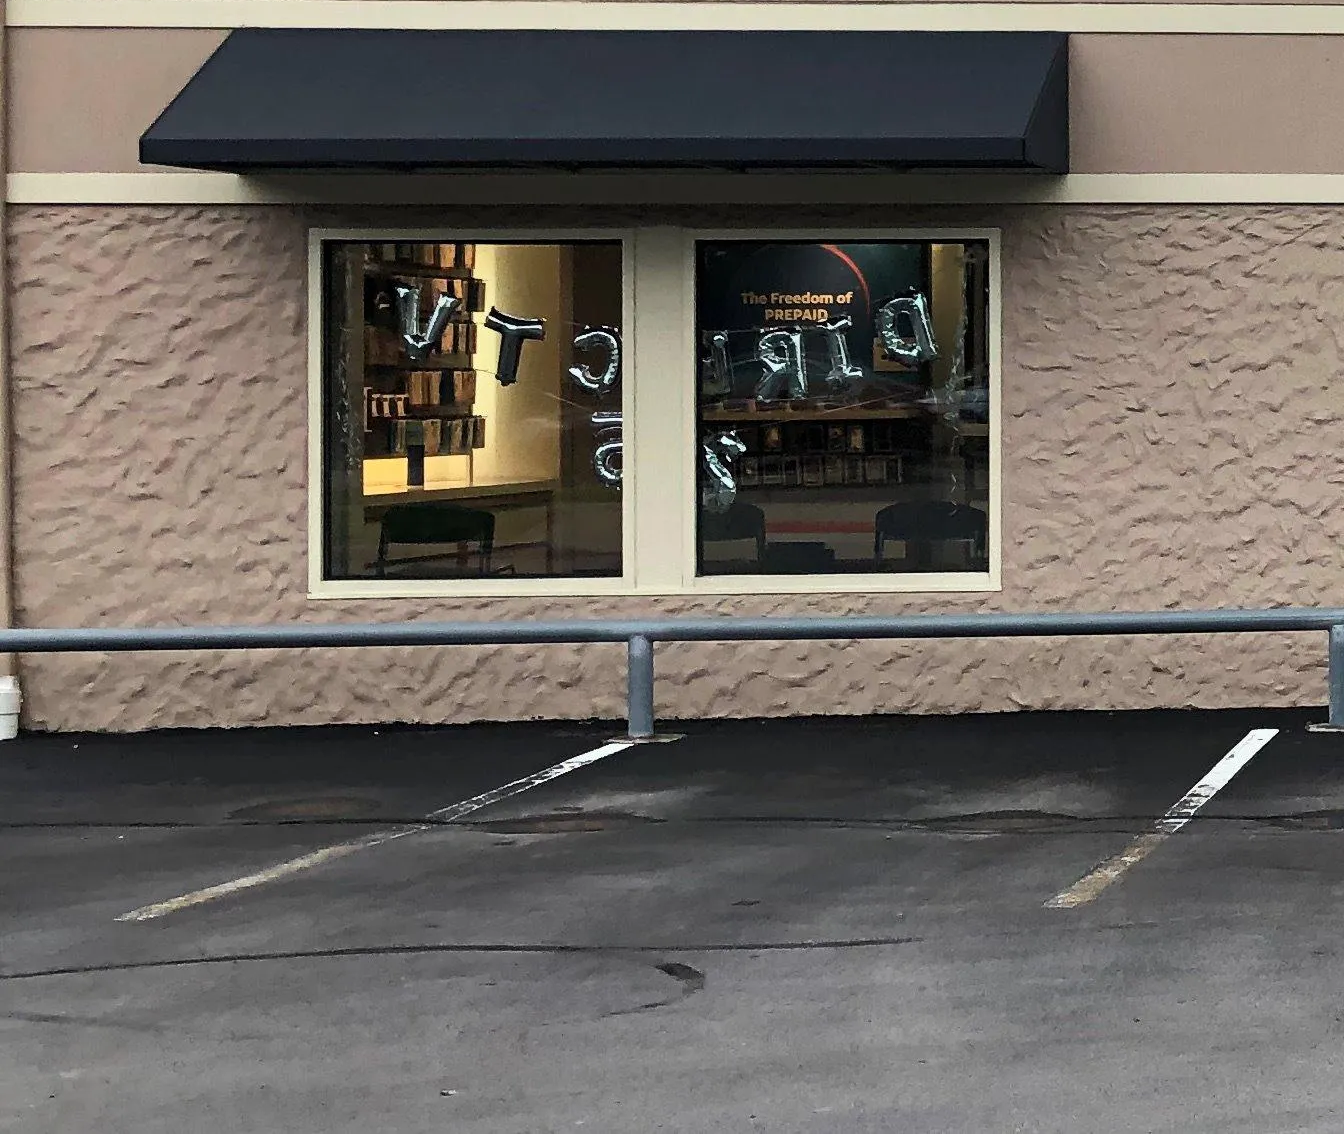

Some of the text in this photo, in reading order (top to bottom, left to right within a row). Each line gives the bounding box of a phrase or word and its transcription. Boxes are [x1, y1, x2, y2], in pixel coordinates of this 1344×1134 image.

[741, 291, 853, 304] The Freedom of
[765, 309, 828, 321] PREPAID
